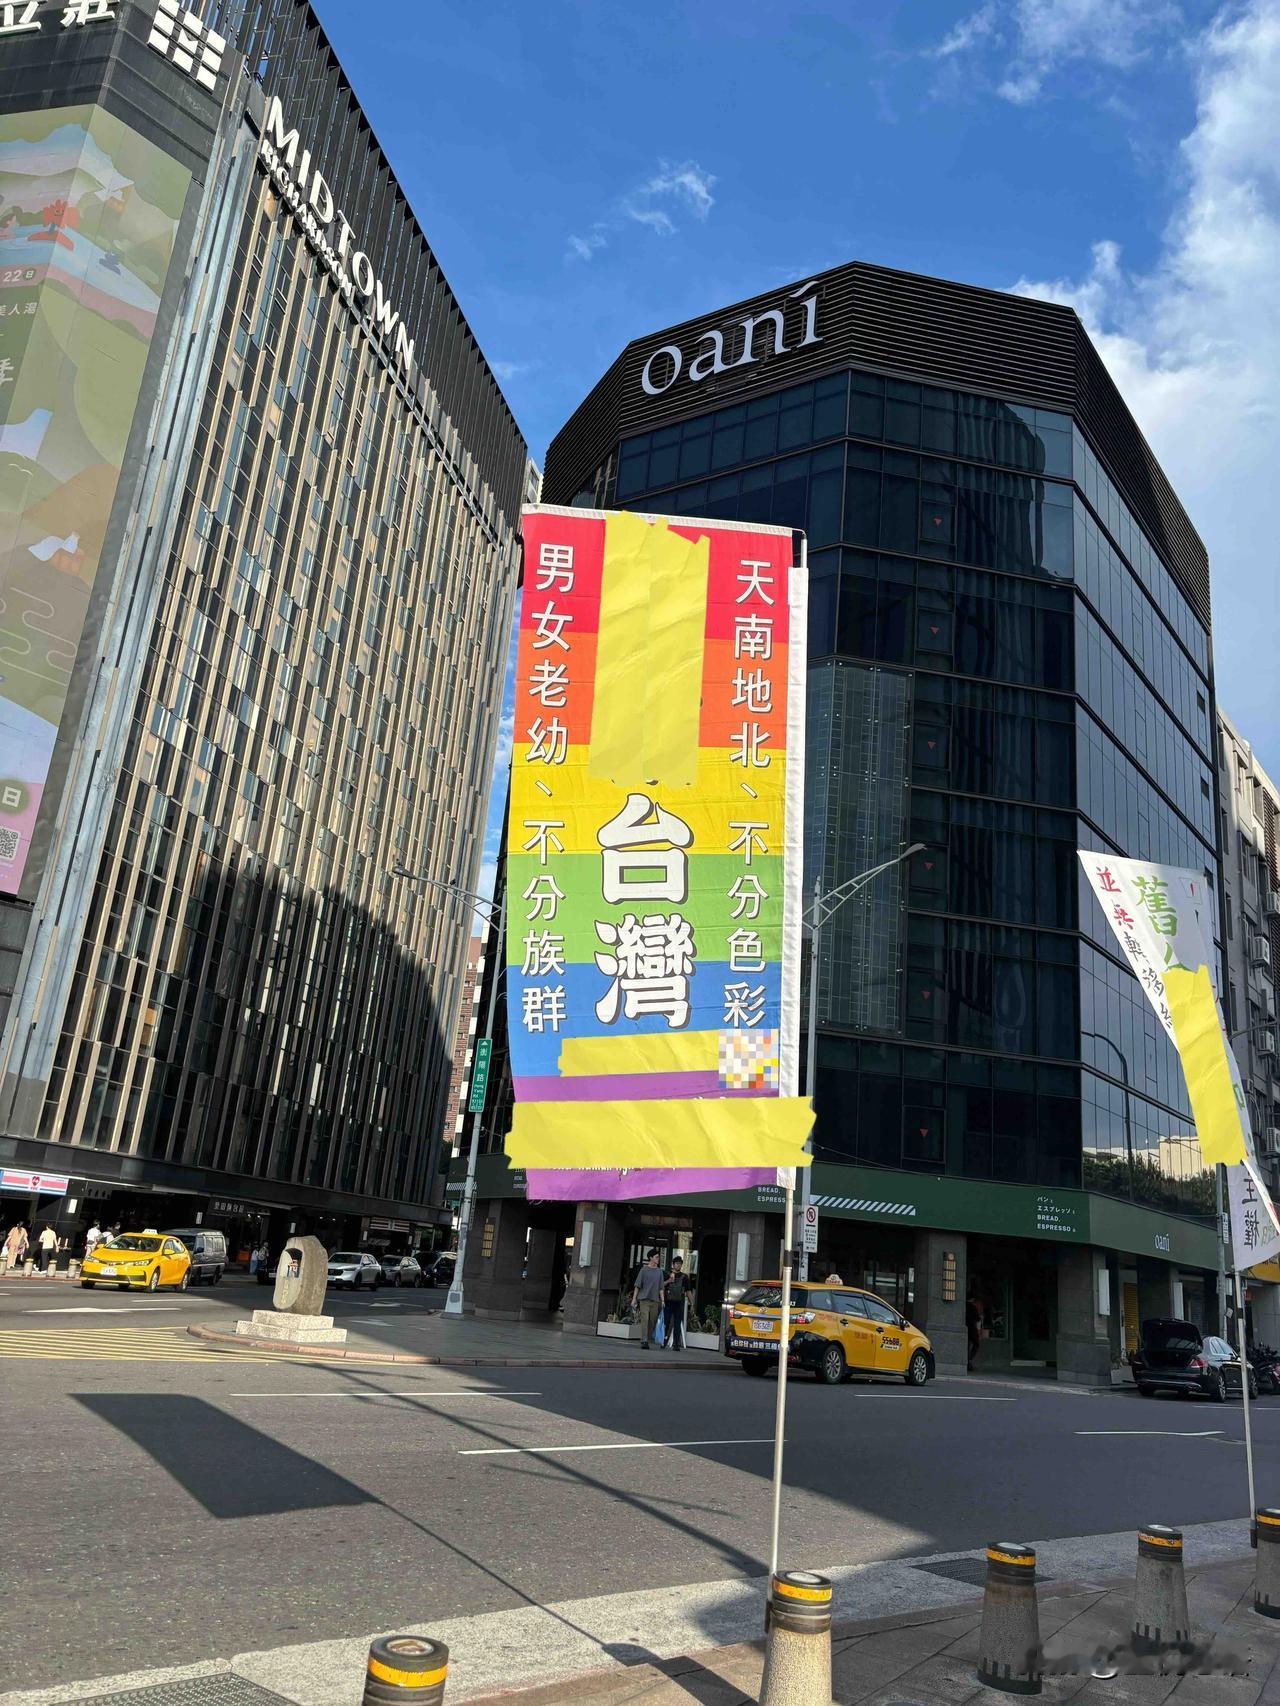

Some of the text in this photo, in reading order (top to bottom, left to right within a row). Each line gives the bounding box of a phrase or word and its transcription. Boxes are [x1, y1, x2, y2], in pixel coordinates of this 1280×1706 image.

[261, 139, 353, 297] RICHARDSON
[267, 95, 415, 370] MIDTOWN
[520, 543, 575, 1033] 男女老幼、不分族群
[723, 559, 775, 1028] 天南地北、不分色彩
[594, 792, 698, 1028] 台灣
[757, 1195, 786, 1203] ESPRESS
[1037, 1214, 1061, 1222] BREAD,
[1037, 1223, 1071, 1232] ESPRESSO
